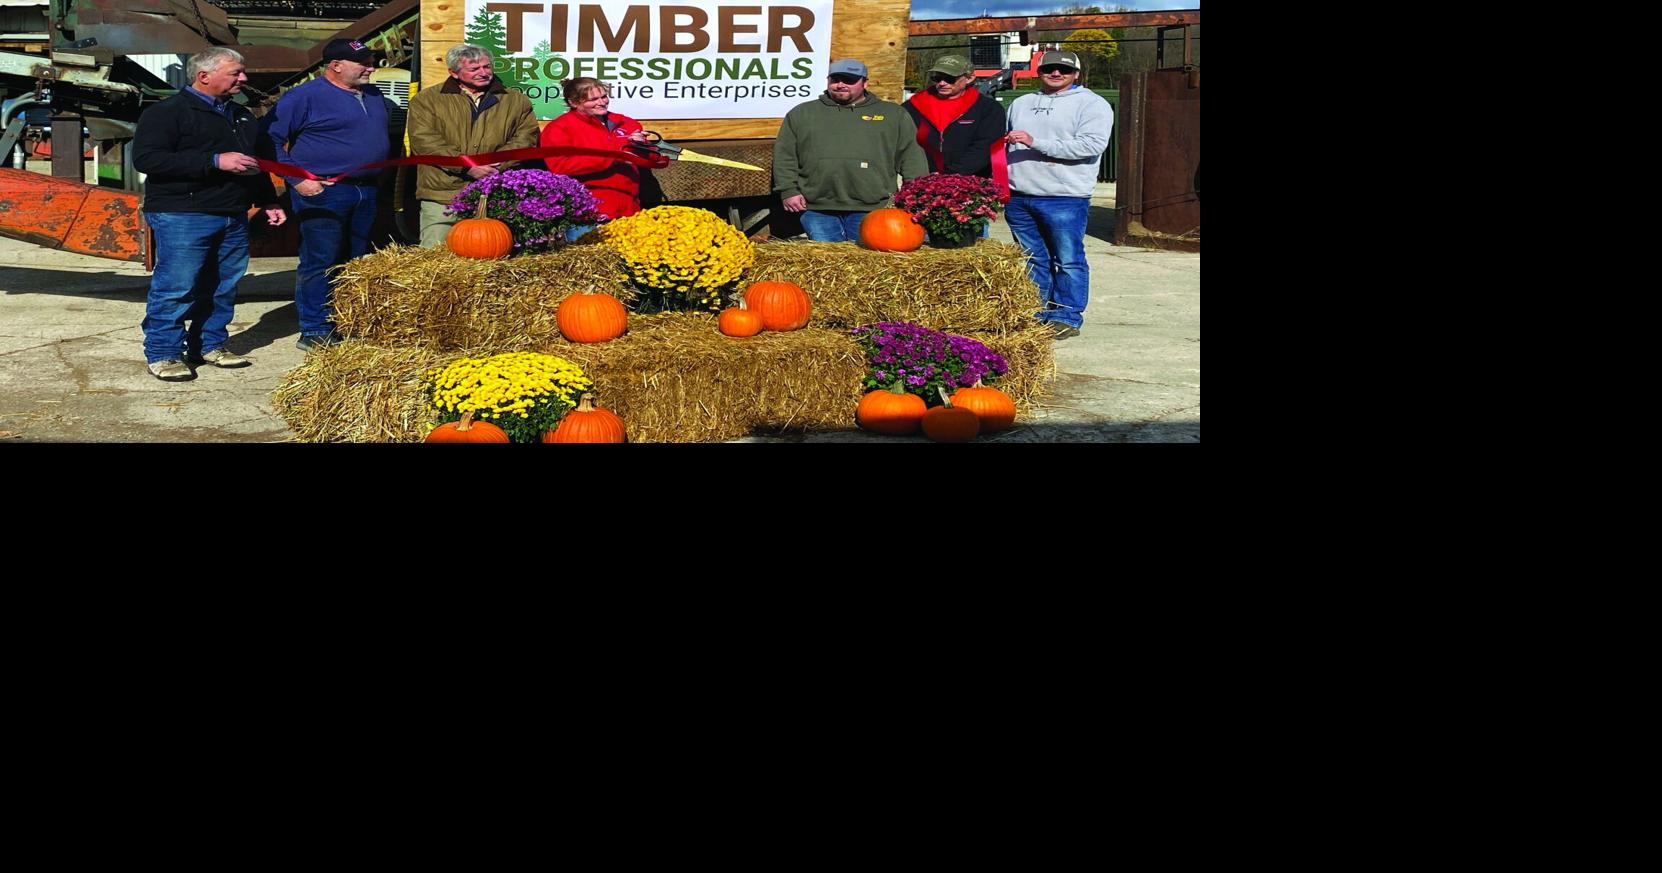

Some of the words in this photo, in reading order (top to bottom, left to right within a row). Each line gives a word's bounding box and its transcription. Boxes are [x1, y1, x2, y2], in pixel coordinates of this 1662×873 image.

[486, 3, 815, 53] TIMBER
[493, 57, 813, 80] PROFESSIONALS
[510, 82, 653, 102] optive
[664, 81, 811, 102] Enterprises
